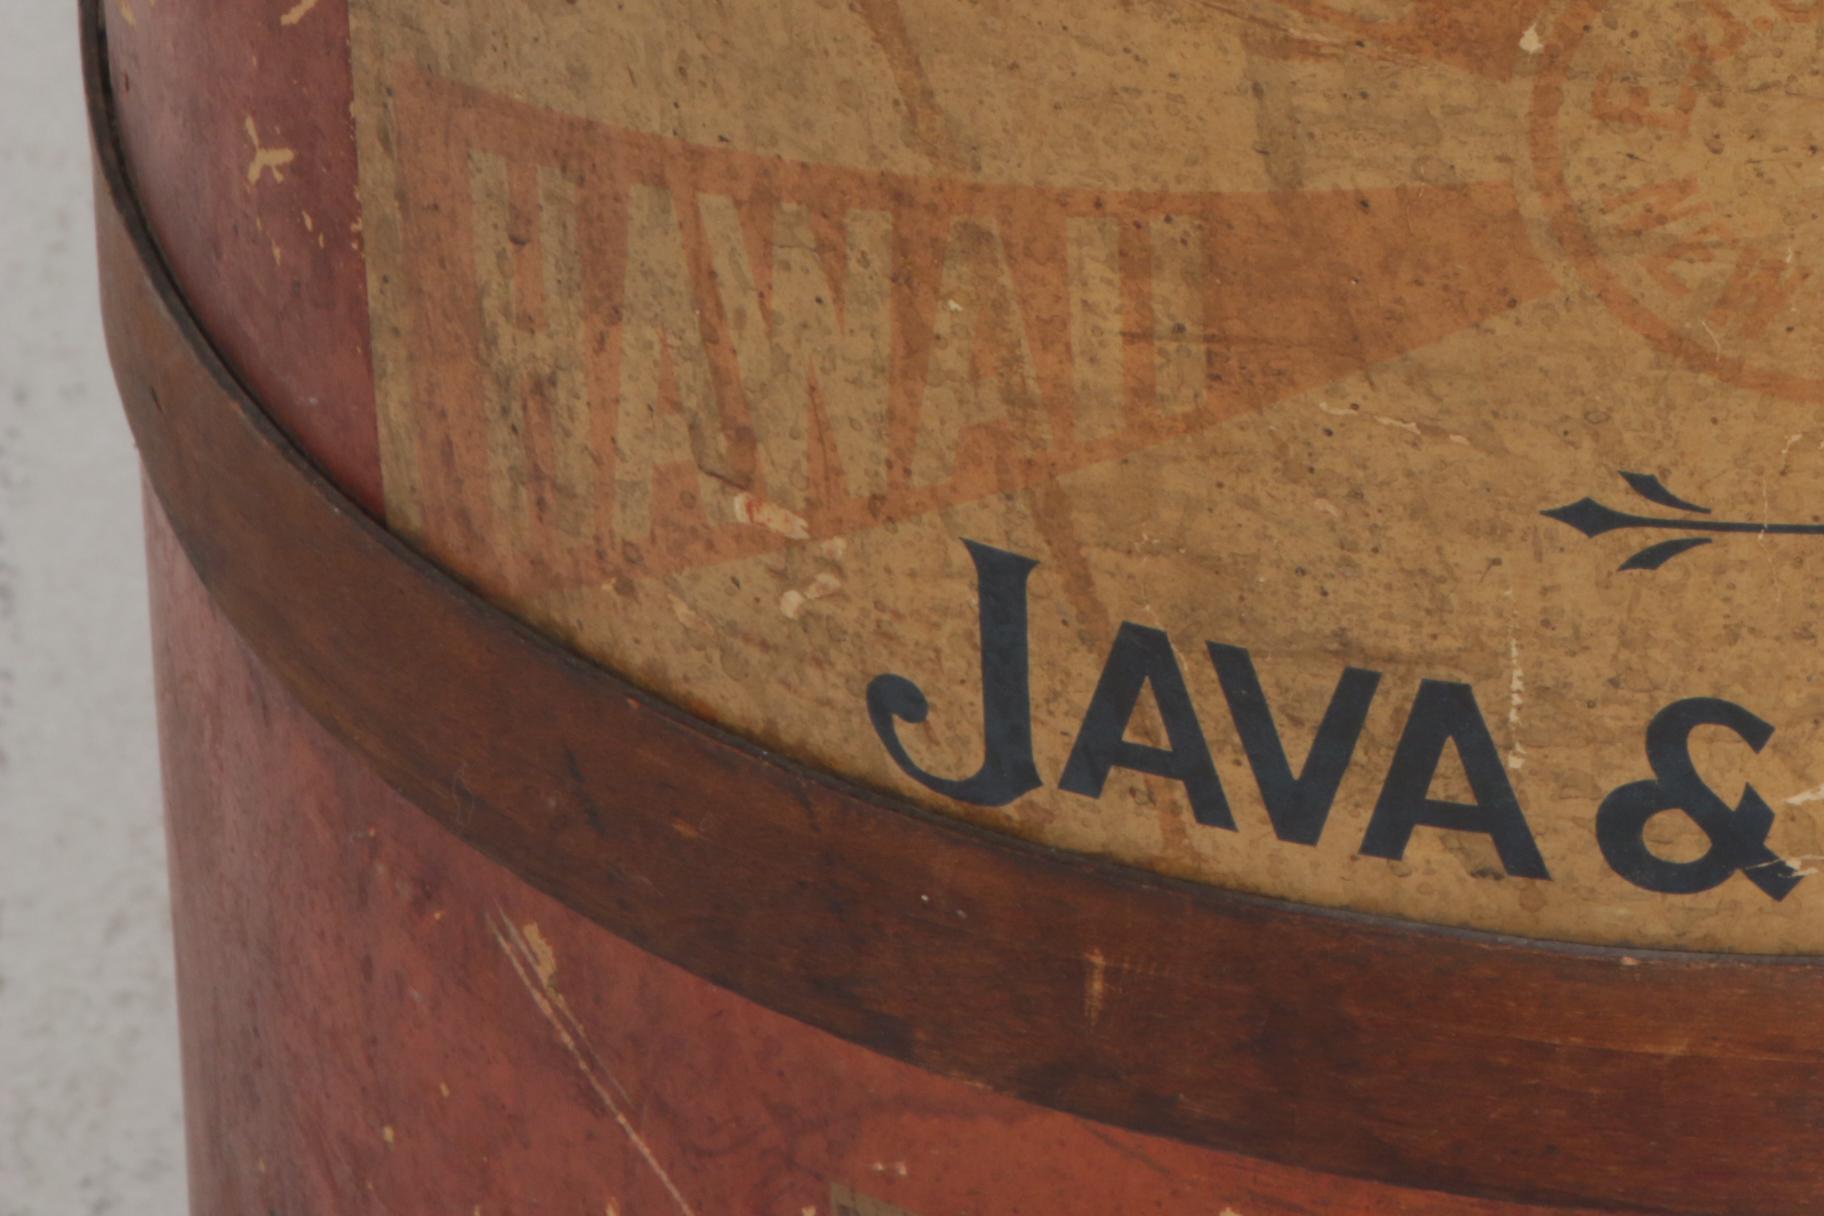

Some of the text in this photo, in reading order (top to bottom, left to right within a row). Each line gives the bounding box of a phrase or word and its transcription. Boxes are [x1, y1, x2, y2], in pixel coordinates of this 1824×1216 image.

[470, 151, 1206, 551] HAWAII
[866, 539, 1549, 880] JAVA
[1596, 695, 1801, 900] &
